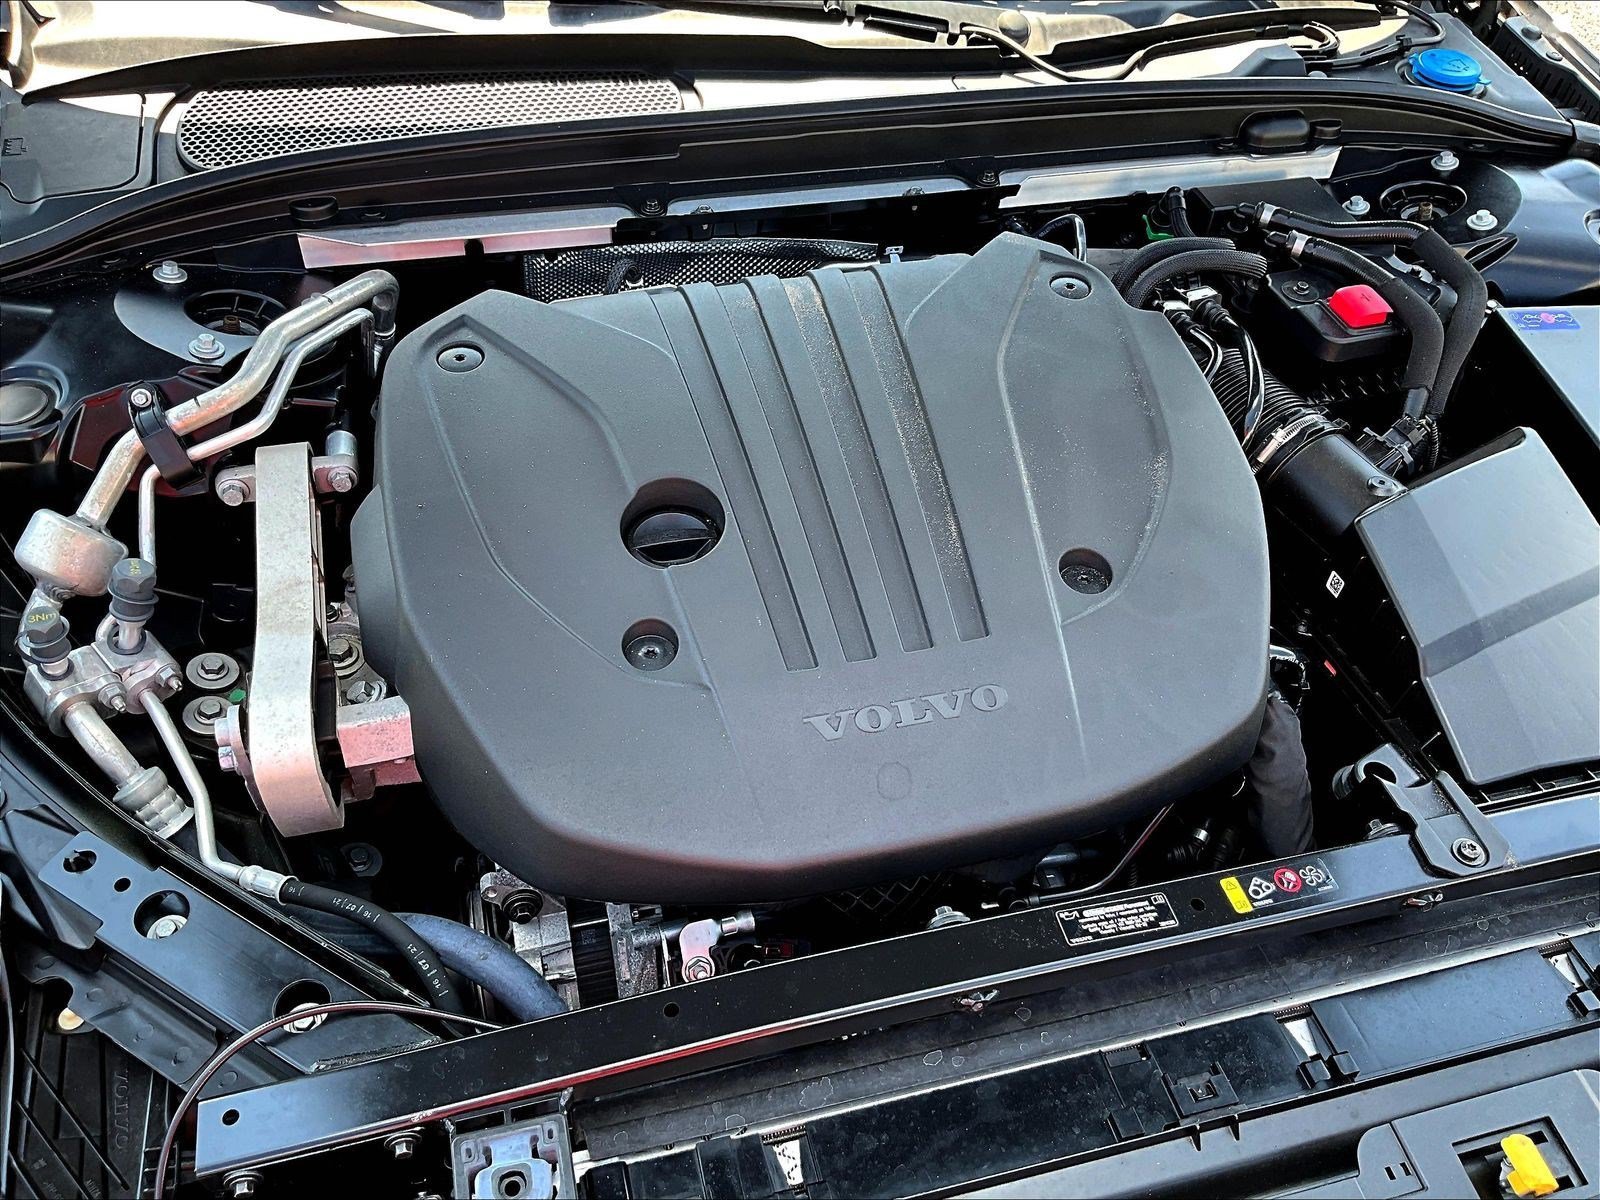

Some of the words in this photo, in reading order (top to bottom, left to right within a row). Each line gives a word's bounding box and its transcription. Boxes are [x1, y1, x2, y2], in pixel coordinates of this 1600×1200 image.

[28, 612, 57, 623] 3Nm
[802, 683, 1009, 742] VOLVO
[345, 903, 357, 911] 07
[406, 943, 417, 954] 21
[417, 959, 430, 970] 07
[432, 978, 441, 989] 16
